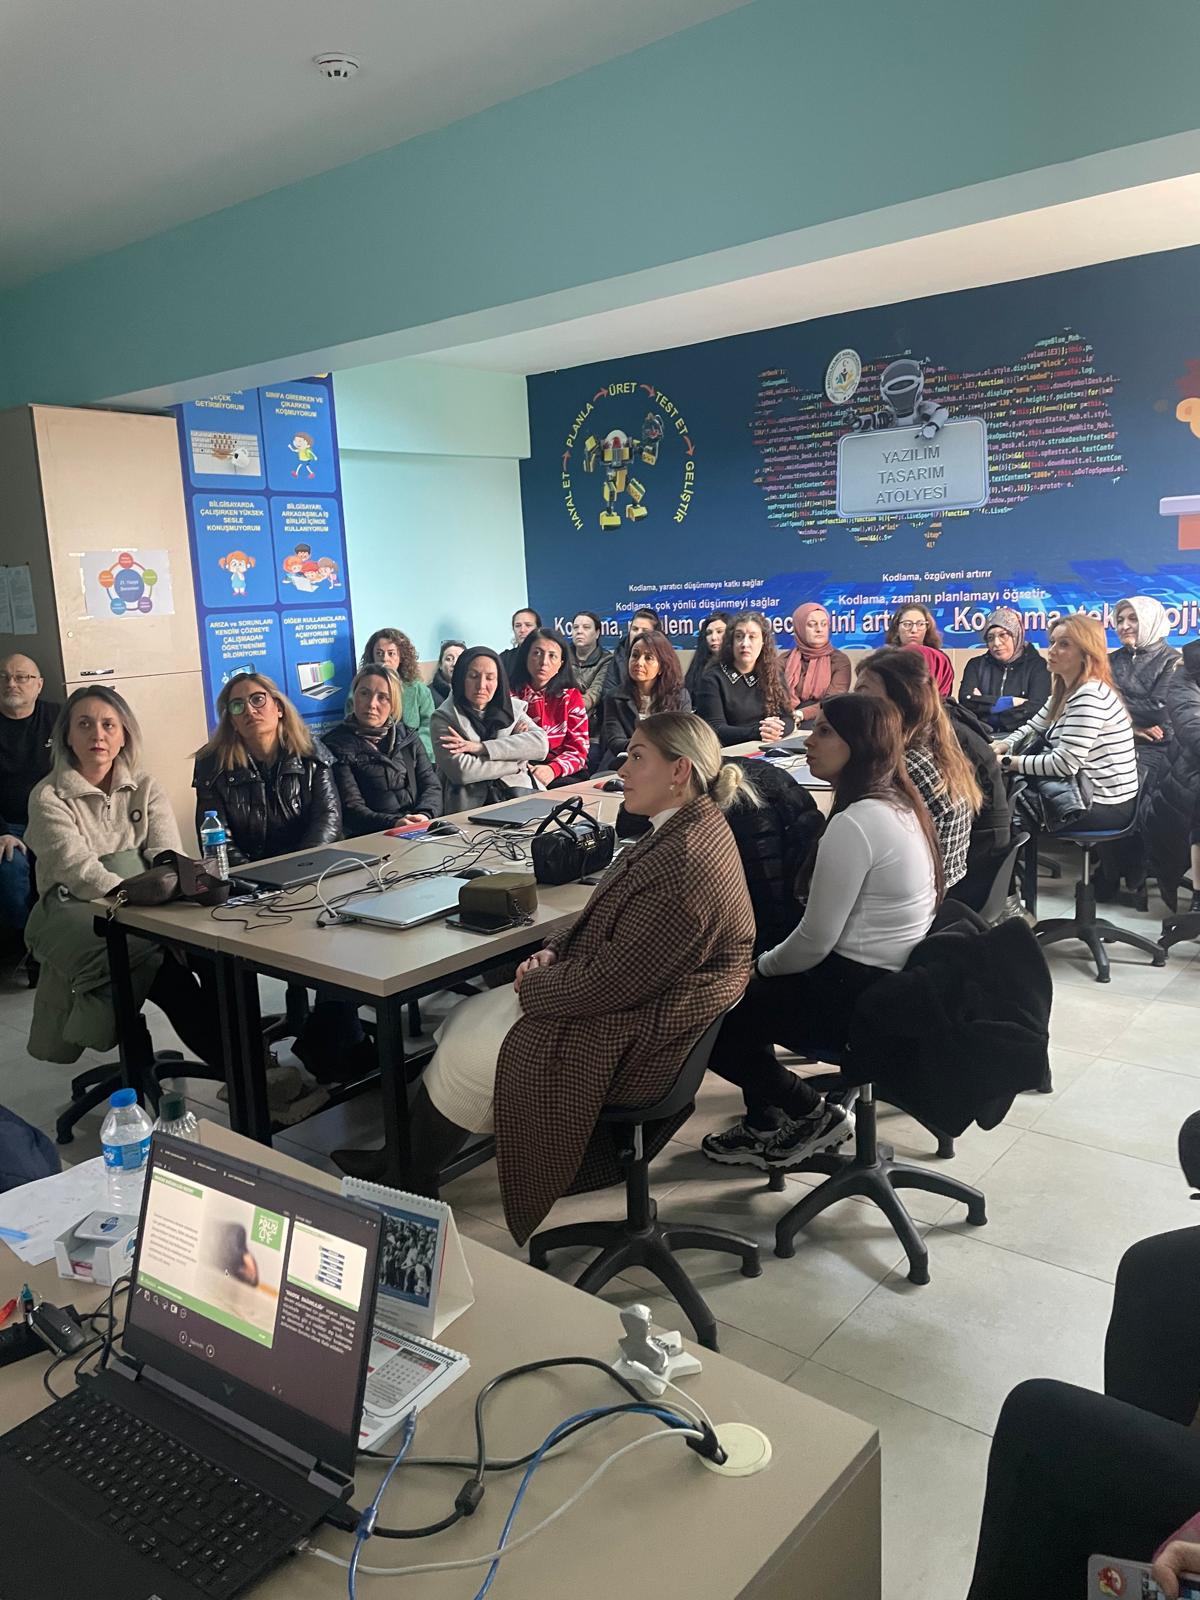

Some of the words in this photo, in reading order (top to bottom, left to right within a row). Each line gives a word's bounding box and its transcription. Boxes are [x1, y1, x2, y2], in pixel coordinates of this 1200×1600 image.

[608, 382, 637, 395] ÜRET
[655, 391, 679, 418] TEST
[674, 417, 689, 435] ET
[566, 402, 594, 447] PLANLA
[882, 446, 940, 464] YAZILIM
[562, 472, 571, 488] ET
[878, 466, 945, 484] TASARIM
[876, 483, 949, 504] ATÖLYESİ
[564, 491, 584, 530] HAYAL
[882, 573, 921, 582] Kodlama,
[924, 571, 964, 581] özgüveni
[966, 570, 992, 579] artırır
[629, 584, 658, 592] Kodlama,
[659, 583, 682, 592] yaratıcı
[684, 581, 722, 591] düşünmeye
[723, 580, 741, 588] katkı
[742, 579, 764, 588] sağlar
[655, 600, 671, 612] çok
[673, 599, 697, 611] yönlü
[699, 598, 748, 610] düşünmeyi
[750, 597, 780, 608] sağlar
[838, 594, 889, 605] Kodlama,
[891, 594, 932, 603] zamanı
[934, 590, 1000, 604] planlamayı
[1003, 588, 1046, 600] öğretir
